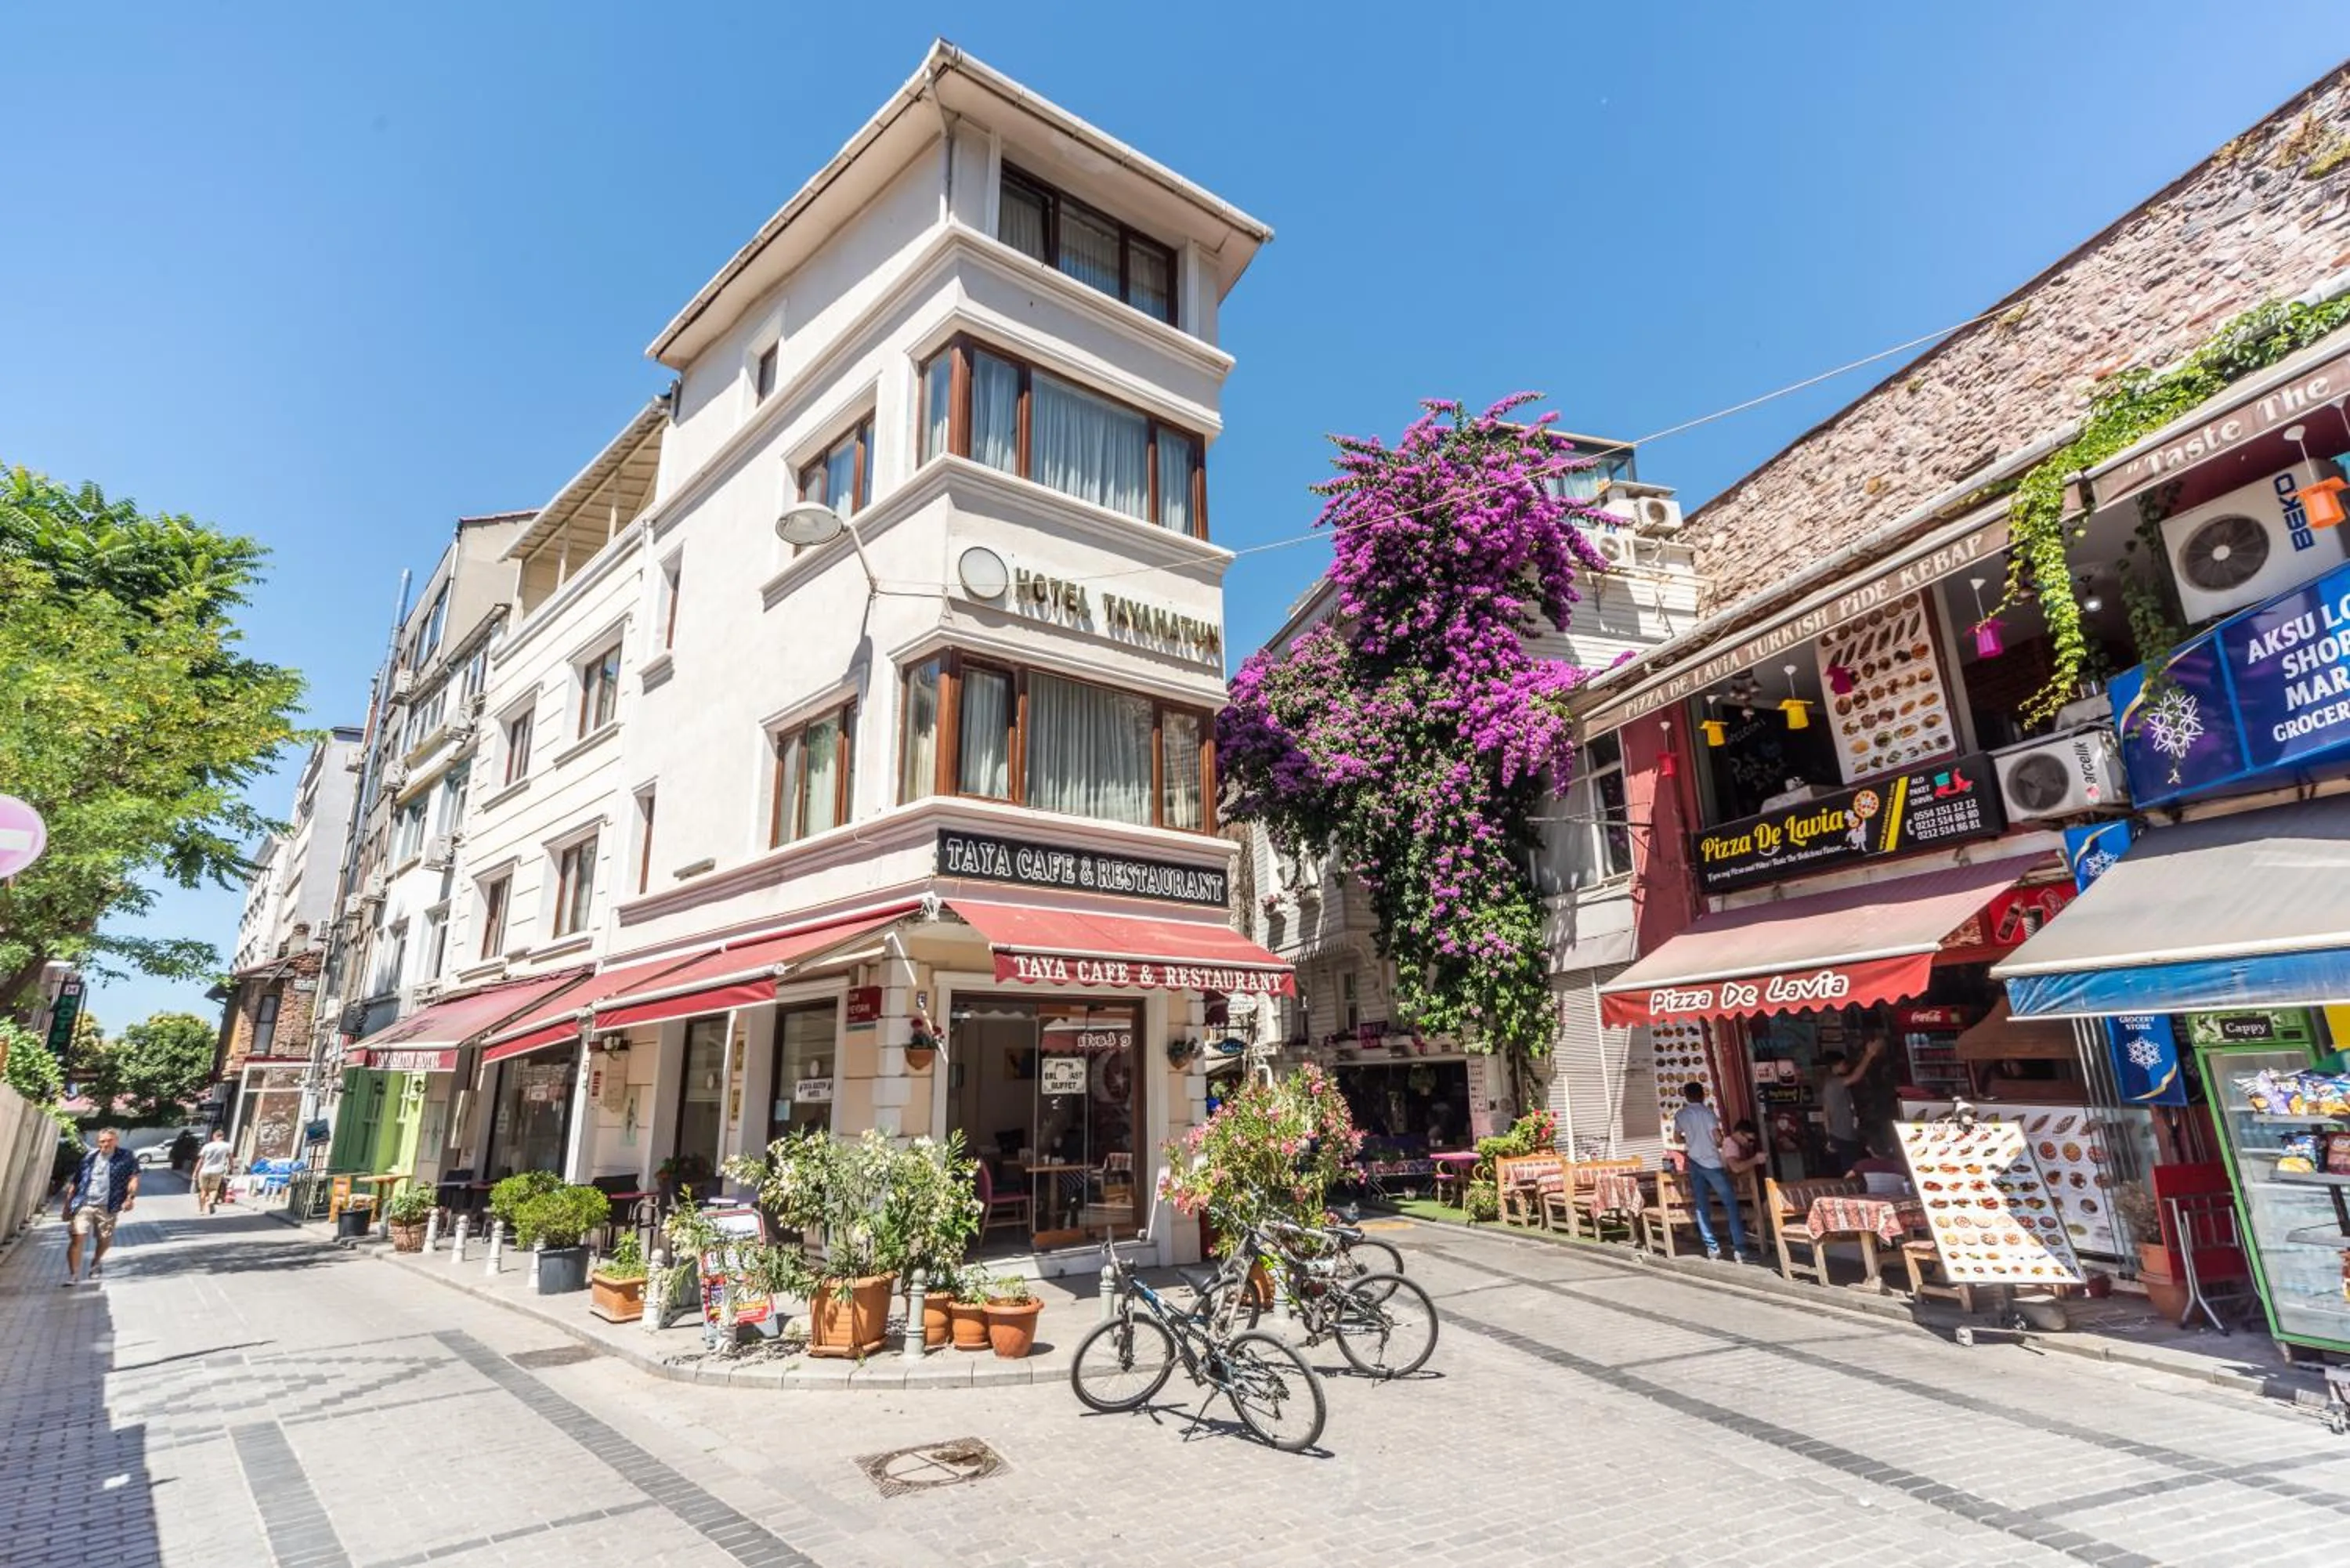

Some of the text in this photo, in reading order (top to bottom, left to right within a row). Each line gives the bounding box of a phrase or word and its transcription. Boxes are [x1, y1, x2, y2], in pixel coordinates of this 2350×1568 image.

[2257, 377, 2330, 422] The
[2274, 472, 2316, 552] BEKO
[1016, 567, 1091, 620] HOTEL
[1669, 677, 1689, 695] DE
[1745, 612, 1828, 659] TURKISH
[1899, 533, 1983, 589] KEBAP
[2248, 612, 2316, 665] AKSU
[2285, 665, 2350, 712] MAR
[2273, 701, 2350, 742] GROCER
[1915, 818, 1936, 831] 0212
[1965, 798, 1978, 809] 12
[1701, 808, 1844, 862] Pizza De Lavia
[1917, 829, 1938, 840] 0212
[945, 838, 1223, 901] TAYA CAFE & RESTAURANT
[1014, 956, 1282, 992] TAYA CAFE & RESTAURANT
[1650, 969, 1850, 1016] Pizza De Lavia
[2225, 1021, 2267, 1035] Cappy
